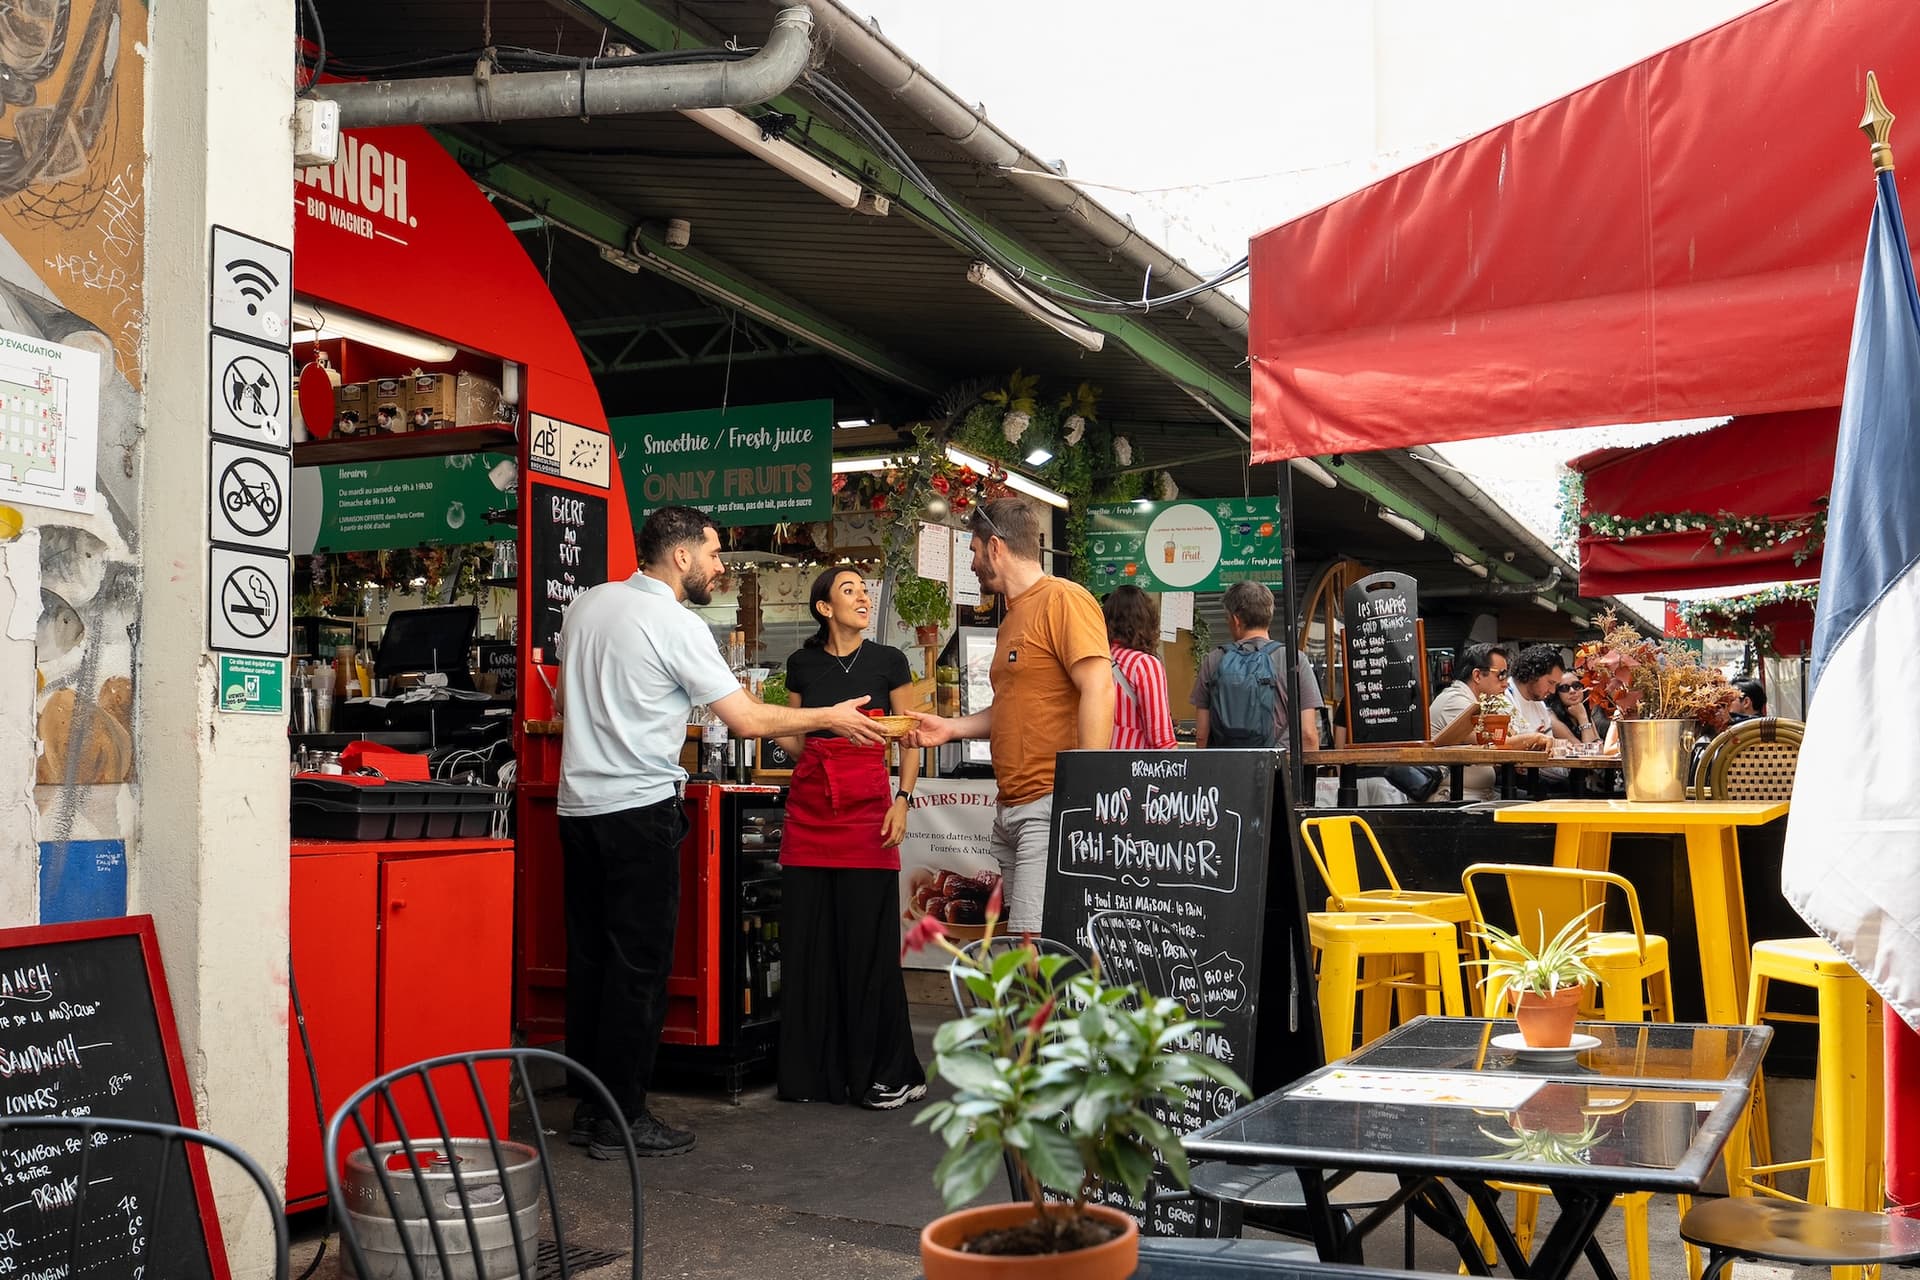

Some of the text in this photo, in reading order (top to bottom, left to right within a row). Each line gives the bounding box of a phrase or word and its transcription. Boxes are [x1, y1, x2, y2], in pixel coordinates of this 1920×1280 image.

[307, 196, 373, 239] BIO WAGNER
[643, 432, 711, 455] Smoothie
[729, 426, 772, 448] Fresh
[772, 426, 814, 452] juice
[348, 487, 364, 496] mardi
[373, 485, 393, 494] samedi
[394, 484, 401, 492] de
[643, 462, 812, 501] ONLY FRUITS
[757, 499, 764, 509] de
[788, 498, 795, 507] de
[564, 526, 577, 544] AU
[960, 793, 981, 806] DE
[1096, 786, 1132, 825] NOS
[947, 831, 972, 841] dattes
